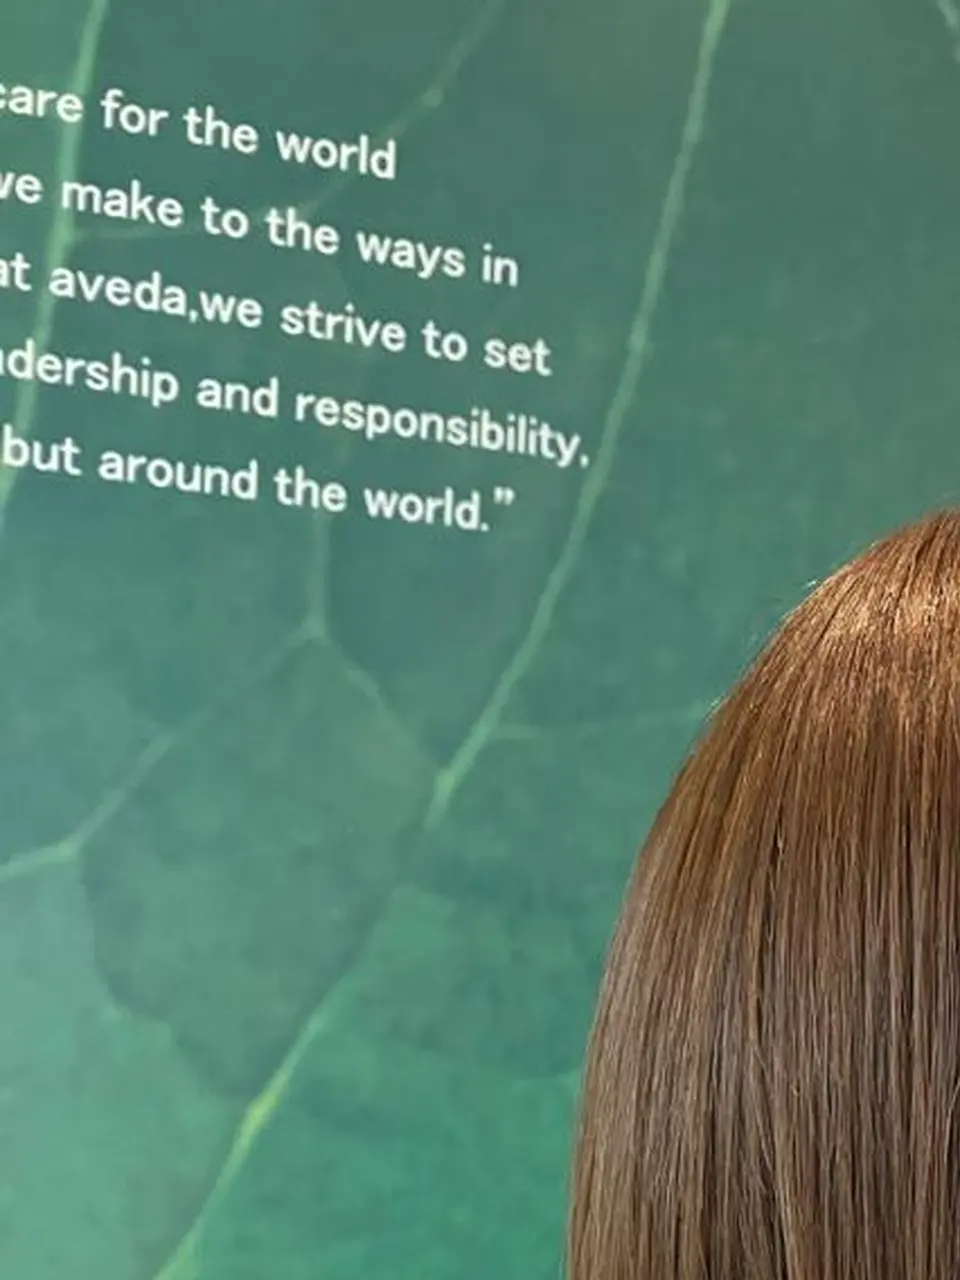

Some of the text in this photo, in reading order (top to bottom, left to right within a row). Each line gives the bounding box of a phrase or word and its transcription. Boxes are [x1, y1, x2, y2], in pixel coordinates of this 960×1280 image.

[0, 83, 397, 180] are for the world
[61, 179, 184, 228] make
[200, 197, 249, 239] to
[265, 207, 340, 255] the
[357, 233, 466, 279] ways
[482, 243, 519, 287] in
[48, 271, 263, 328] aveda,we
[281, 302, 407, 352] strive
[422, 321, 468, 362] to
[484, 340, 552, 376] set
[0, 338, 590, 468] dership and responsibility,
[1, 424, 82, 476] but
[98, 451, 258, 500] around
[274, 466, 347, 513] the
